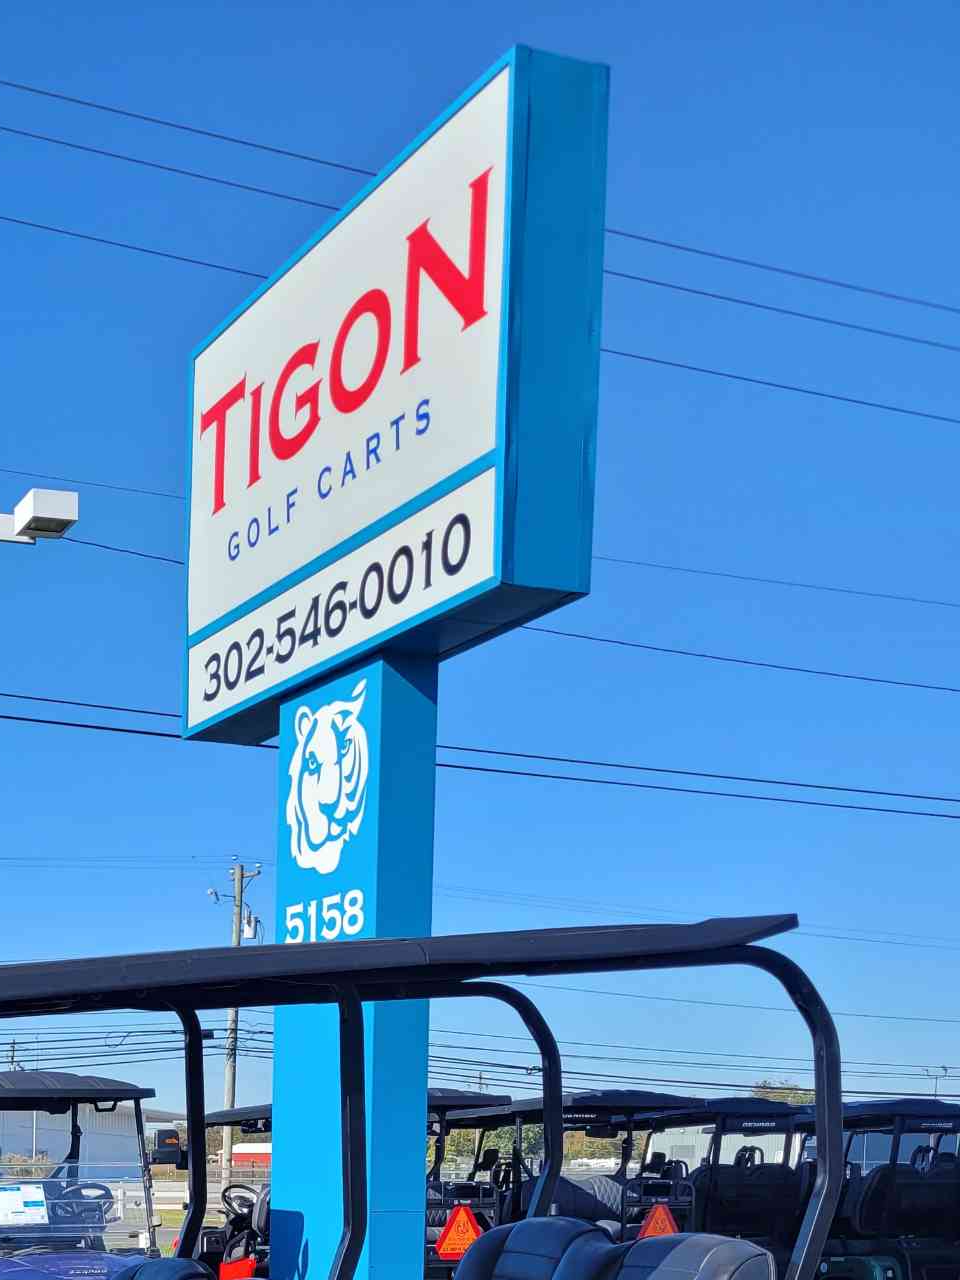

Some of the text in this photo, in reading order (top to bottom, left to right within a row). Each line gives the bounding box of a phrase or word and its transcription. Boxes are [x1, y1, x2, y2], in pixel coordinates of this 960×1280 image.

[200, 166, 495, 517] TIGON
[227, 398, 431, 562] GOLF CARTS
[202, 513, 472, 702] 302-546-0010
[284, 889, 364, 943] 5158
